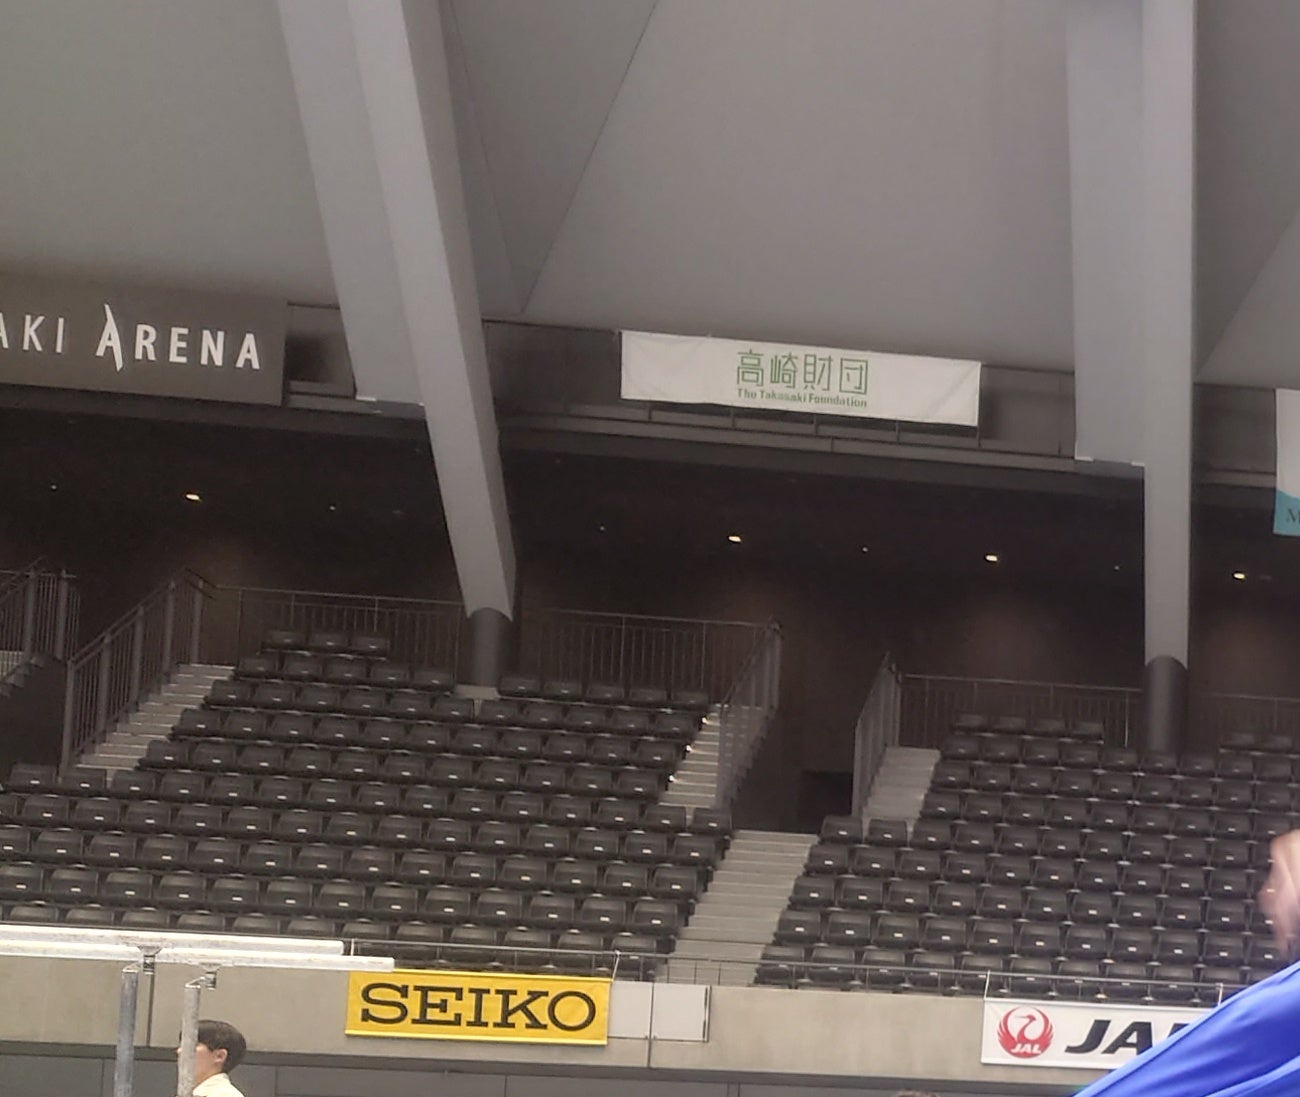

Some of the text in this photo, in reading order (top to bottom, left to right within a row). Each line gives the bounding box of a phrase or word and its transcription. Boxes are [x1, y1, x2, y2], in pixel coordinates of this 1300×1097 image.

[96, 303, 261, 372] ARENA
[737, 349, 869, 396] 高崎財団
[361, 982, 596, 1032] SEIKO
[1011, 1042, 1042, 1055] JAL
